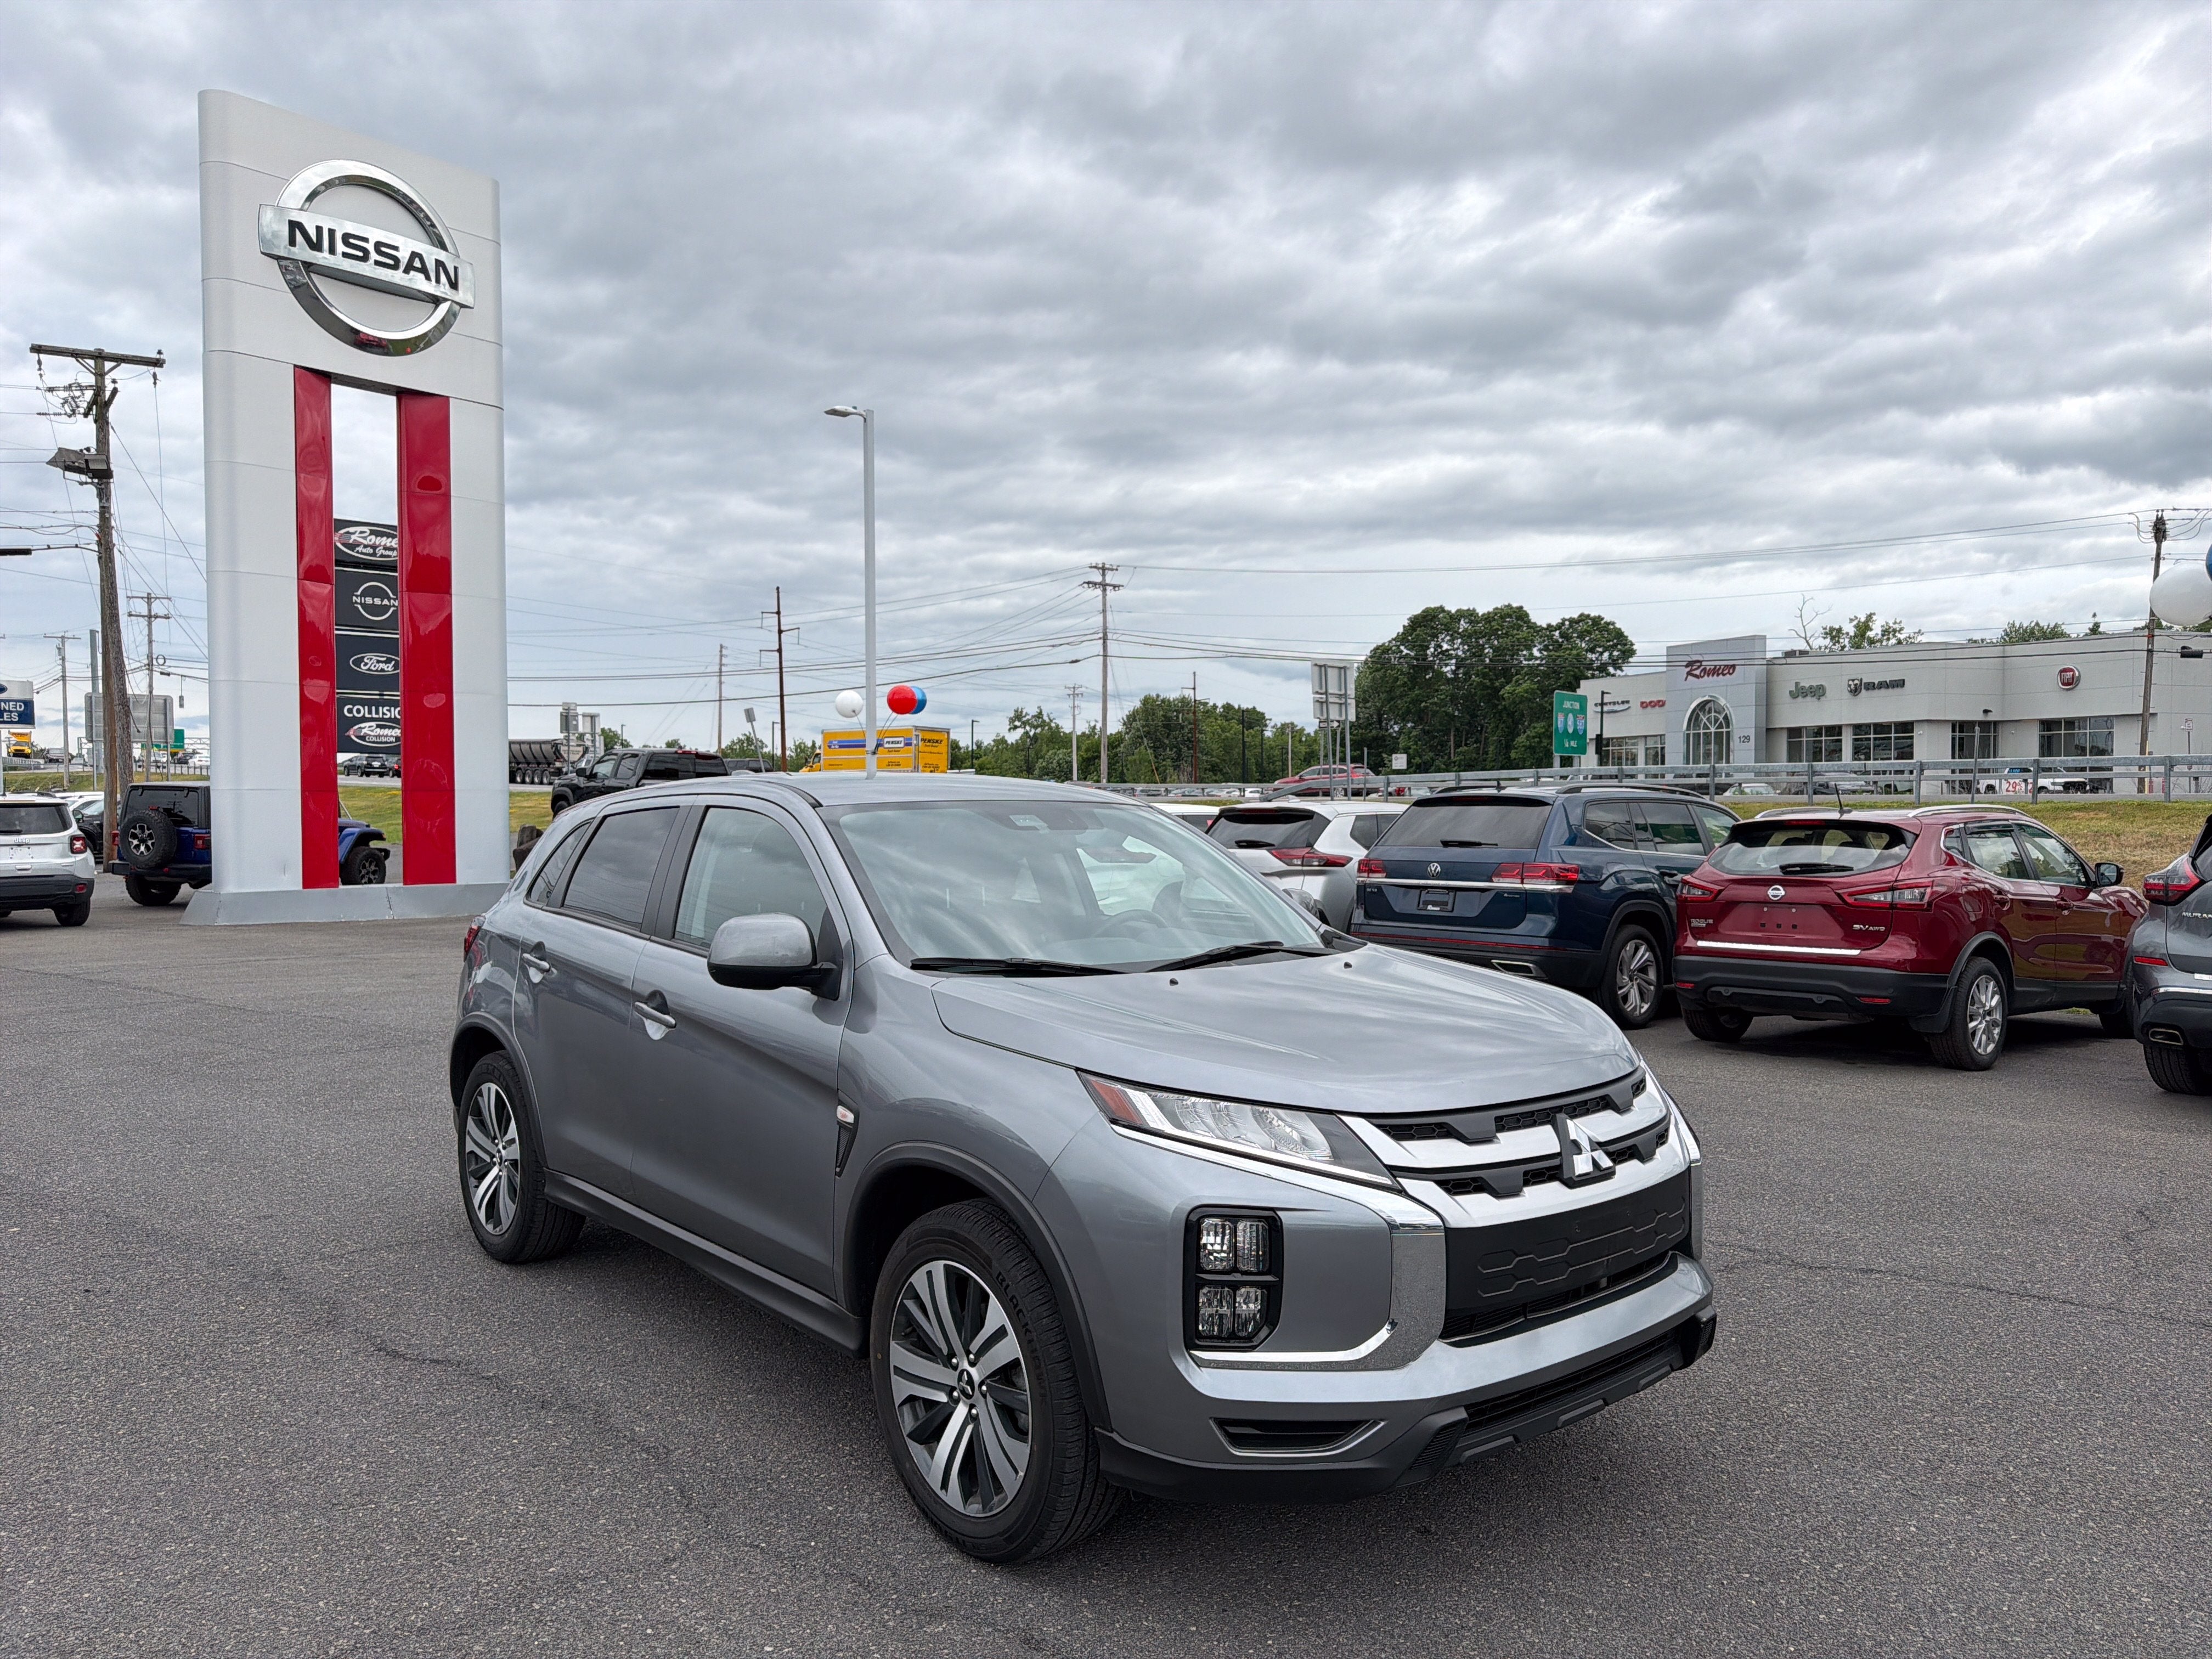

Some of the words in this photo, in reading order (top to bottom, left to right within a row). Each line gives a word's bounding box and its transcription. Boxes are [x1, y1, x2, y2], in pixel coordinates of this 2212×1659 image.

[288, 219, 459, 291] NISSAN
[349, 528, 398, 548] Rome
[354, 545, 373, 554] Auto
[376, 546, 397, 557] Group
[352, 596, 398, 606] NISSAN
[360, 656, 396, 672] Ford
[1684, 659, 1736, 681] Romeo
[2061, 672, 2073, 683] FIAT
[1863, 679, 1905, 691] RAM
[1789, 681, 1827, 702] Jeep
[1, 702, 25, 711] NED
[1640, 699, 1666, 709] DOD
[343, 704, 401, 719] COLLISI
[1738, 735, 1751, 743] 129
